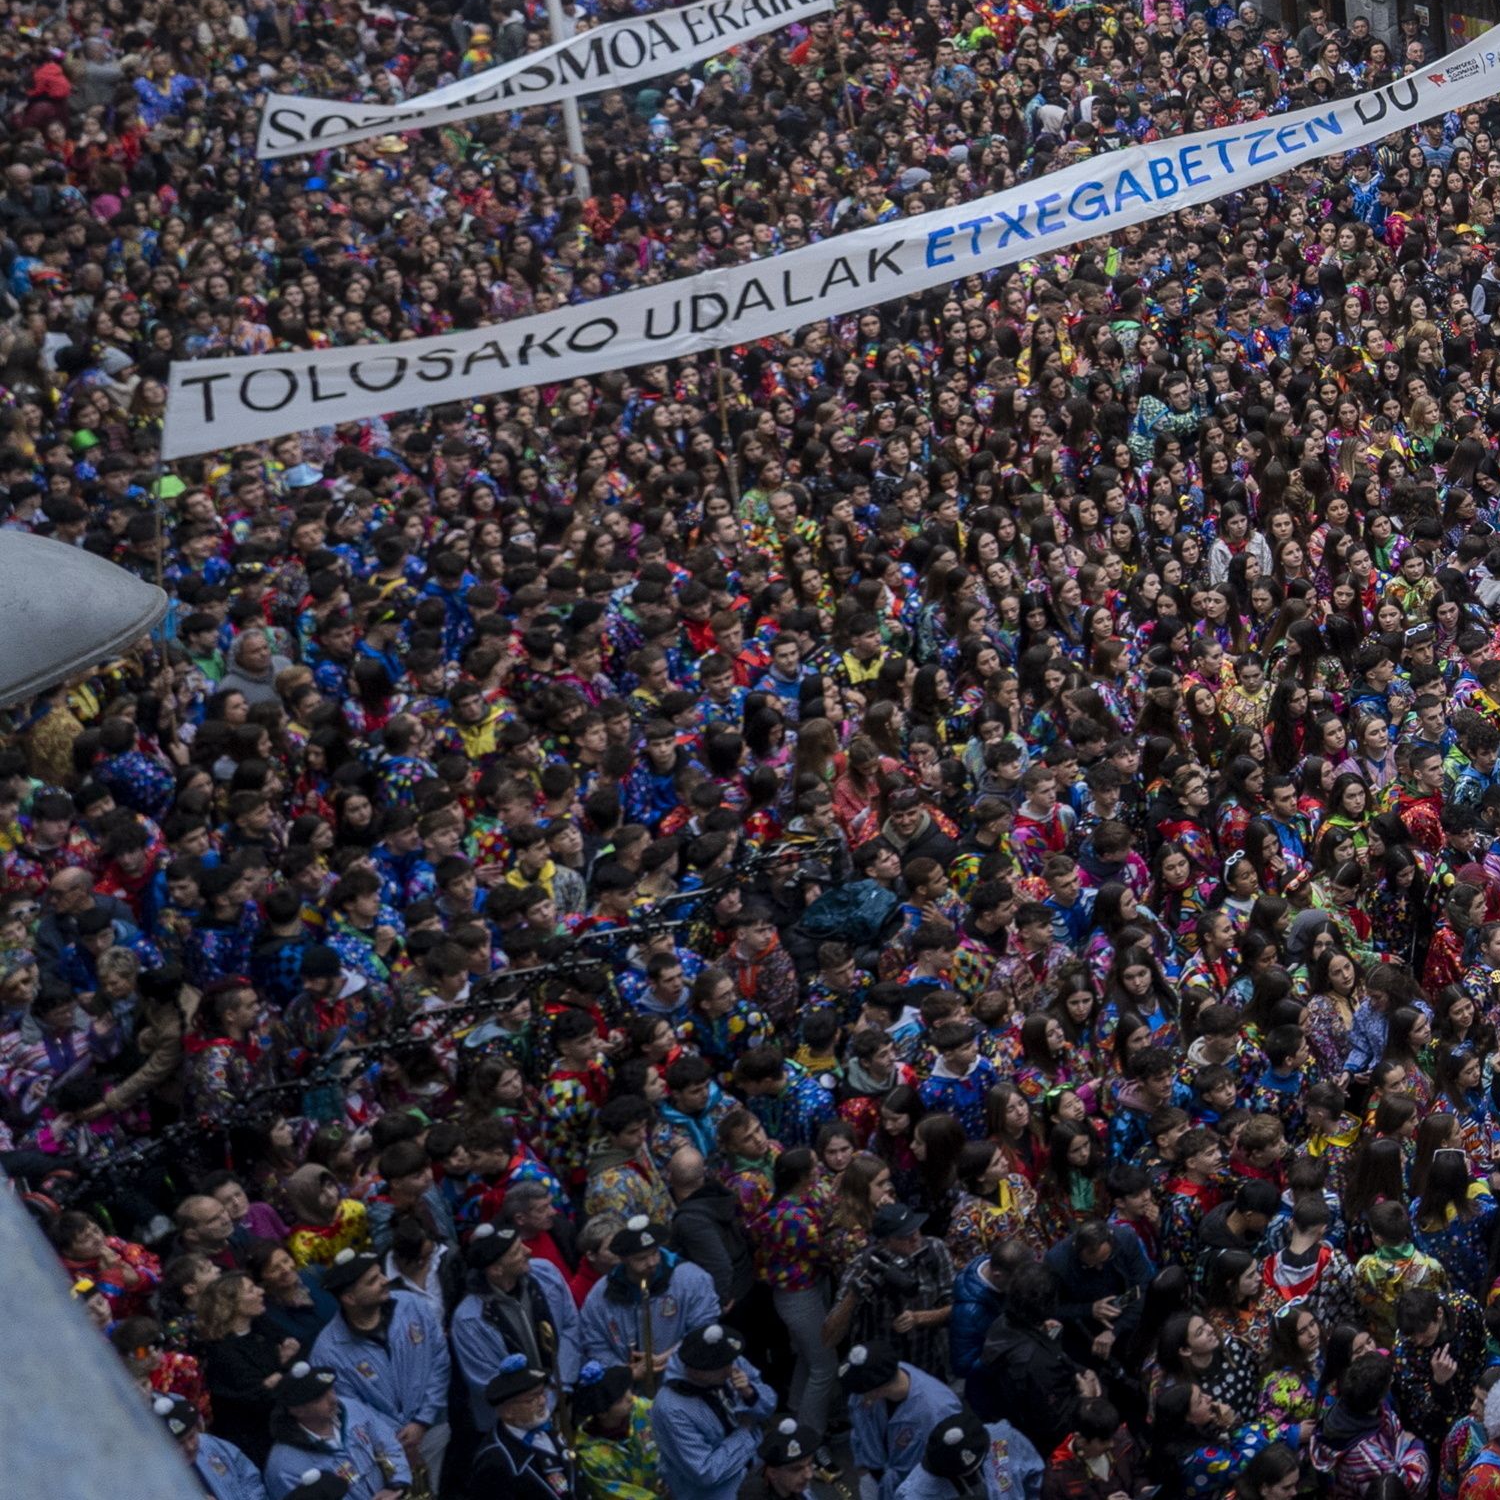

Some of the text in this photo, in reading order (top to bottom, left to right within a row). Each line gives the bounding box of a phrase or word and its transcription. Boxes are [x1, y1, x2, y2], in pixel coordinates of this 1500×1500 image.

[181, 77, 1420, 422] TOLOSAKO UDALAK ETXEGABETZEN DU
